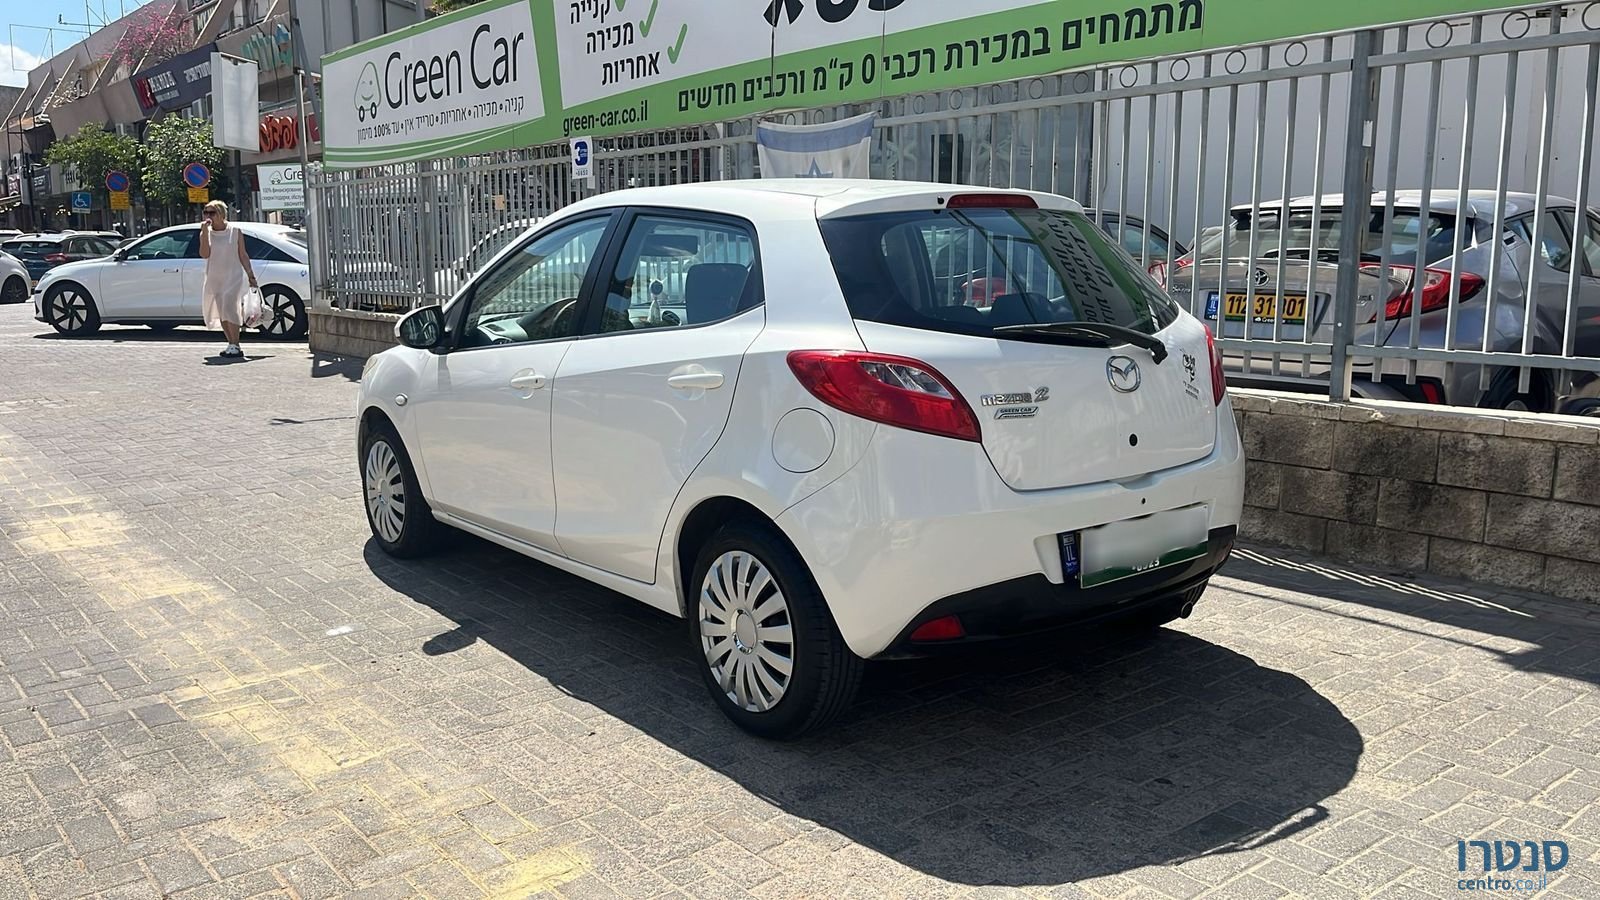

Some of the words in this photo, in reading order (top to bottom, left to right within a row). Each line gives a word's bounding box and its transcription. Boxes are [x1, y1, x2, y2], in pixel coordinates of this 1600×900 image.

[586, 22, 634, 54] מכירה
[1062, 0, 1202, 51] מתמחים
[883, 48, 935, 80] רכבי
[944, 26, 1050, 72] במכירת
[384, 50, 462, 109] Green
[470, 24, 524, 89] Car
[601, 51, 660, 85] אחריות
[861, 53, 875, 84] 0
[678, 82, 736, 112] חדשים
[743, 70, 805, 102] ורכבים
[416, 113, 434, 129] טרייד
[440, 107, 467, 125] אחריות
[473, 101, 497, 119] מכירה
[504, 96, 524, 115] קניה
[563, 99, 648, 137] green-car.co.il
[373, 123, 391, 138] 100%
[1034, 386, 1050, 403] 2
